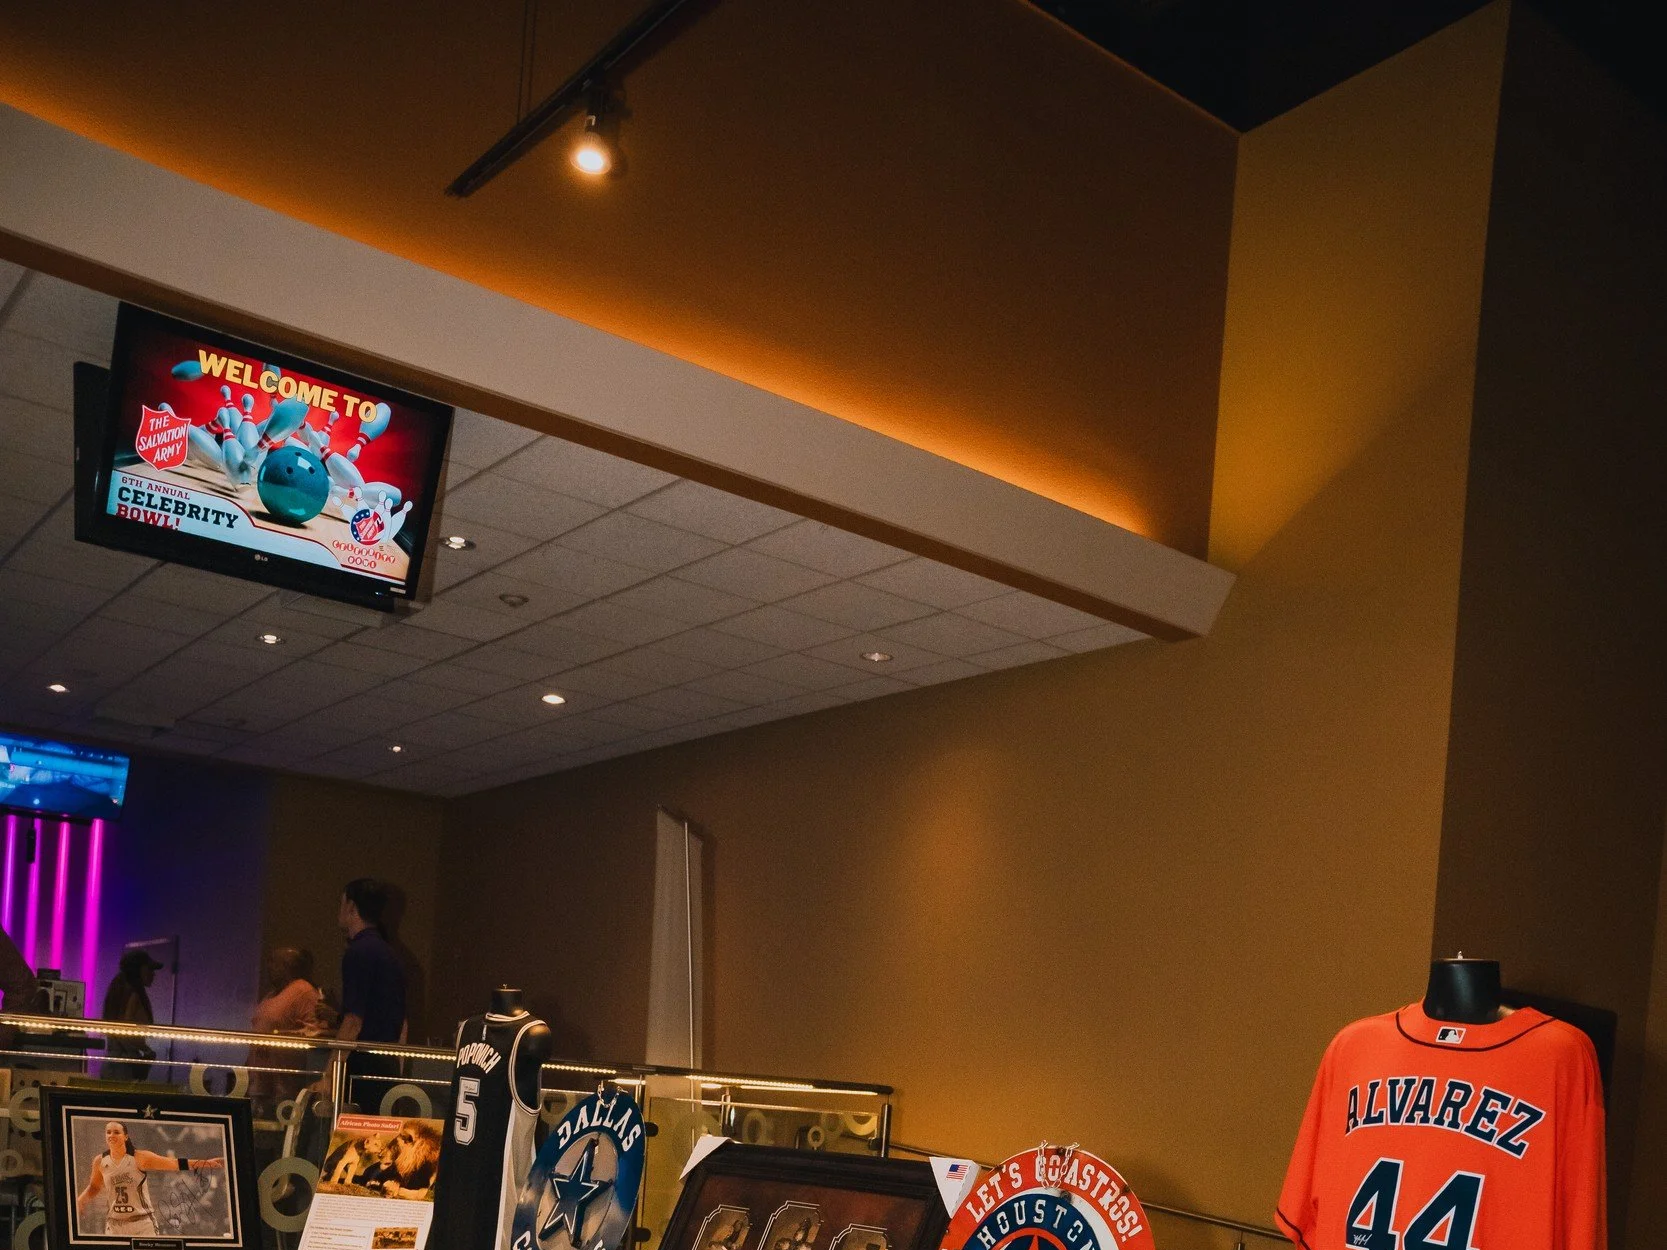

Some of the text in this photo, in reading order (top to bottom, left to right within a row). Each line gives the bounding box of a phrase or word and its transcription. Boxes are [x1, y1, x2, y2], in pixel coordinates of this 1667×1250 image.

[199, 350, 377, 423] WELCOME TO
[138, 423, 187, 453] SALVATION
[149, 415, 170, 432] THE
[153, 440, 183, 464] ARMY
[121, 476, 190, 500] 6TH ANNUAL
[115, 503, 181, 530] BOWL!
[117, 486, 239, 528] CELEBRITY
[457, 1042, 501, 1074] POPOVICH
[454, 1076, 480, 1146] 5
[557, 1099, 642, 1152] DALLAS
[1345, 1076, 1546, 1160] ALVAREZ
[966, 1162, 1024, 1223] LET'S
[1064, 1158, 1143, 1242] ASTROS!
